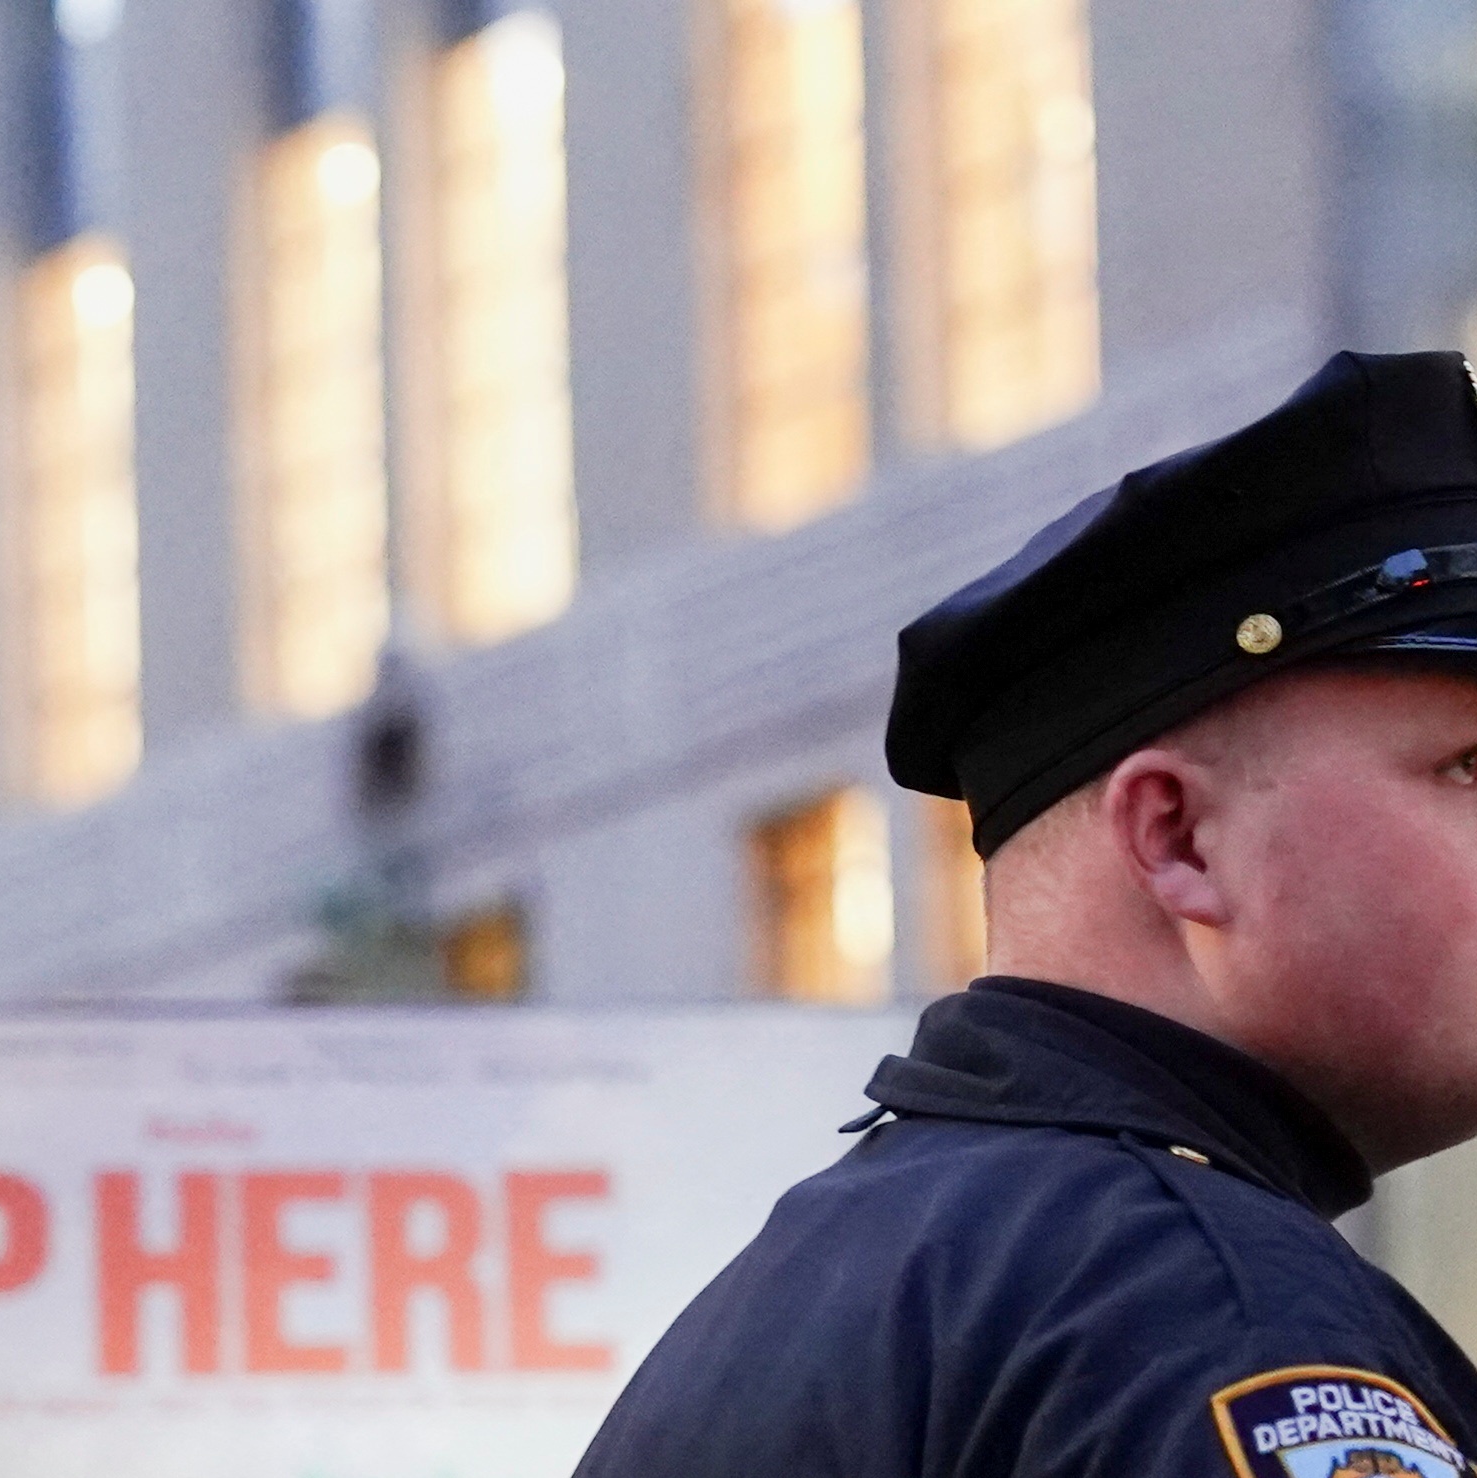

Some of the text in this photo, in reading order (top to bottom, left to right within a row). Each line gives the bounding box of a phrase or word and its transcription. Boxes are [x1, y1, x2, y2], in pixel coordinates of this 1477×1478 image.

[95, 1170, 614, 1376] HERE
[1290, 1384, 1422, 1425] POLICE
[1253, 1411, 1468, 1471] DEPARTMENT
